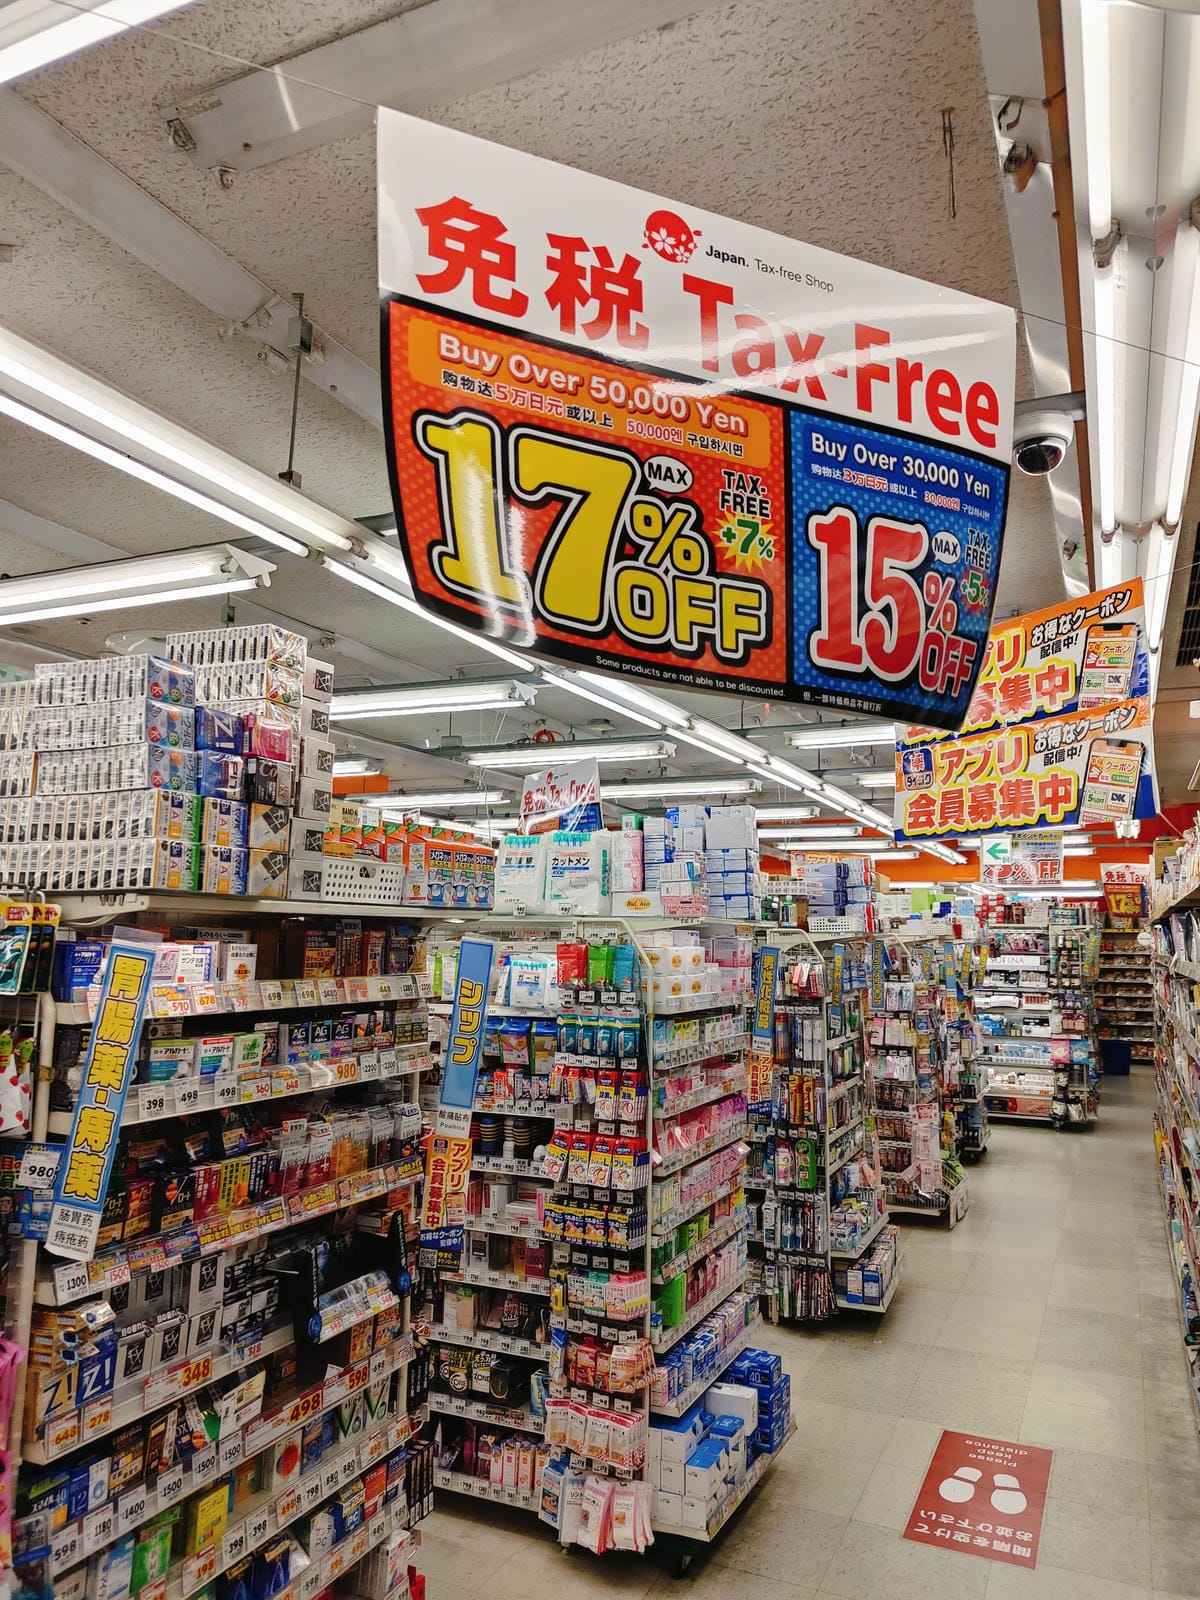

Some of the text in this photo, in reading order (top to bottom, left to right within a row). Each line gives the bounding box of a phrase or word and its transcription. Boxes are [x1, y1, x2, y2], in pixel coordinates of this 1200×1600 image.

[415, 196, 649, 349] 免税
[705, 245, 834, 292] Japan. Tax-free Shop
[683, 274, 1000, 447] Tax-Free
[439, 333, 748, 436] Buy Over 50,000 Yen
[626, 420, 743, 457] 50,000엔 구입하시면
[647, 462, 688, 486] MAX
[811, 432, 991, 499] Buy Over 30,000 Yen
[719, 491, 772, 518] FREE
[721, 518, 773, 559] +7%
[934, 539, 959, 558] MAX
[964, 549, 991, 570] FREE
[961, 572, 988, 605] +5%
[613, 567, 770, 658] OFF
[1031, 590, 1131, 648] お得なクーポン
[919, 631, 977, 697] OFF
[1103, 645, 1131, 655] クーポン
[596, 655, 786, 697] Some products are not able to be discounted.
[1034, 706, 1137, 753] お得なクーポン
[940, 736, 1023, 787] アプリ
[1105, 760, 1136, 772] クーポン
[907, 773, 1072, 830] 会員募集中
[552, 857, 591, 866] カットメン
[757, 955, 775, 1029] 男性化粧品
[293, 1028, 306, 1038] AG
[315, 1026, 327, 1036] AG
[336, 1024, 349, 1034] AG
[452, 978, 483, 1063] シップ
[337, 1063, 356, 1079] 980
[440, 1122, 465, 1131] Poultice
[450, 1141, 467, 1189] アプリ
[560, 1153, 565, 1161] S
[603, 1158, 608, 1166] L
[425, 1158, 447, 1227] 会員募集中
[183, 1358, 210, 1387] 348
[349, 1367, 368, 1390] 598
[290, 1393, 321, 1422] 498
[55, 1428, 76, 1444] 648
[965, 1440, 1028, 1456] distance
[969, 1453, 1017, 1468] please
[977, 1449, 1011, 1460] keep
[914, 1523, 1031, 1557] 間隔を空けて
[920, 1510, 1033, 1542] お並び下さい
